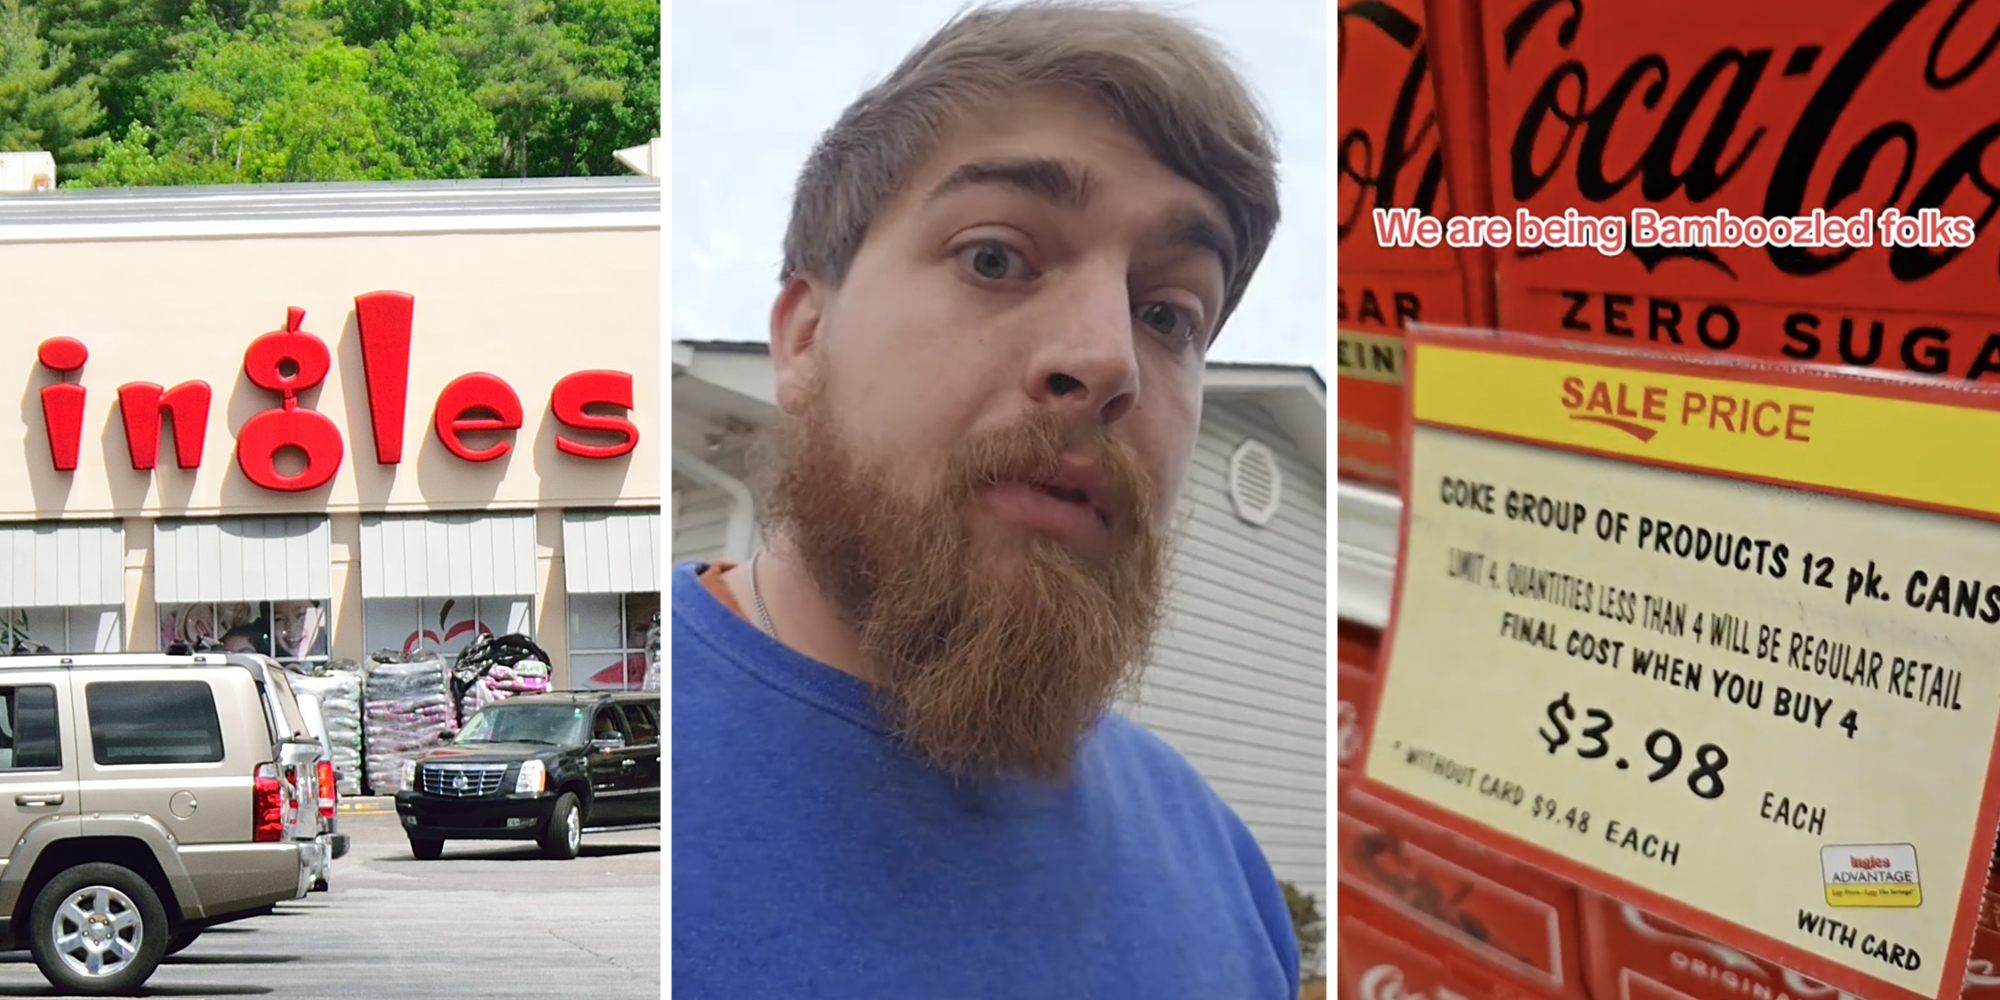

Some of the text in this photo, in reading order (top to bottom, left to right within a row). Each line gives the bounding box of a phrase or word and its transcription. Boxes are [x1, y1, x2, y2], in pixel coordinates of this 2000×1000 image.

[1561, 290, 1740, 349] ZERO
[38, 290, 640, 491] ingles
[1561, 376, 1814, 442] SALE PRICE
[1441, 476, 2000, 624] COKE GROUP OF PRODUCTS 12 pk. CANS
[1448, 546, 1486, 585] LIMIT
[1507, 562, 1594, 614] QUANTITIES
[1598, 583, 1637, 625] LESS
[1642, 594, 1688, 638] THAN
[1692, 611, 1704, 644] 4
[1710, 612, 1750, 655] WILL
[1756, 623, 1782, 663] BE
[1787, 631, 1884, 691] REGULAR
[1888, 656, 1963, 711] RETAIL
[1500, 610, 1859, 739] FINAL COST WHEN YOU BUY 4
[1538, 690, 1730, 801] $3.98
[1405, 746, 1682, 867] WITHOUT CARD $9.48 EACH
[1760, 791, 1827, 836] EACH
[1832, 870, 1913, 883] ADVANTAGE
[1797, 908, 1858, 949] WITH
[1860, 933, 1922, 971] CARD
